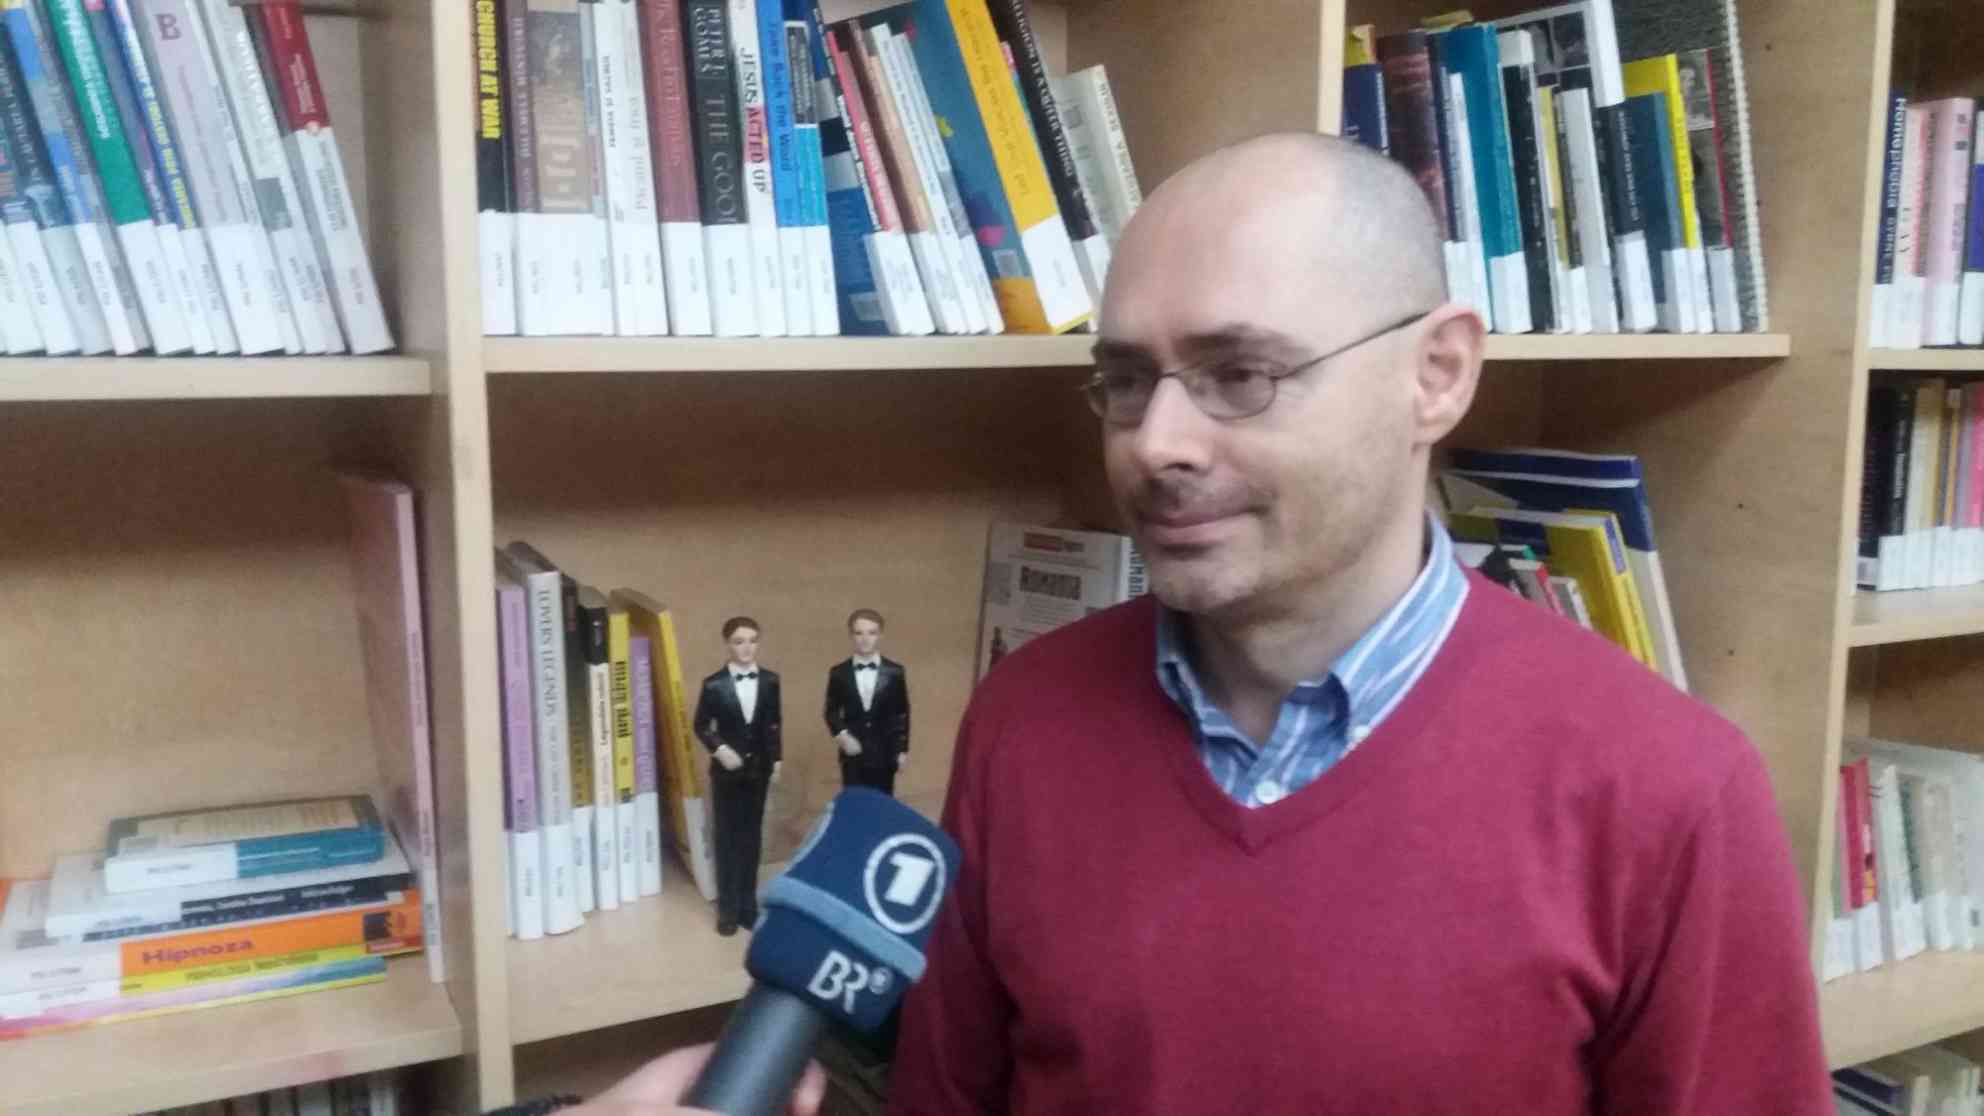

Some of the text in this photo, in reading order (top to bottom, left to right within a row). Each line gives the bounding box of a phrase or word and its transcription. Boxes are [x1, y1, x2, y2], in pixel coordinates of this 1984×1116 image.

[475, 0, 498, 71] CHURCH
[481, 98, 501, 139] WAR
[706, 96, 730, 145] THE
[740, 47, 768, 193] JESUS ACTED UP
[141, 938, 254, 967] Hipnoza
[805, 949, 870, 1015] BR
